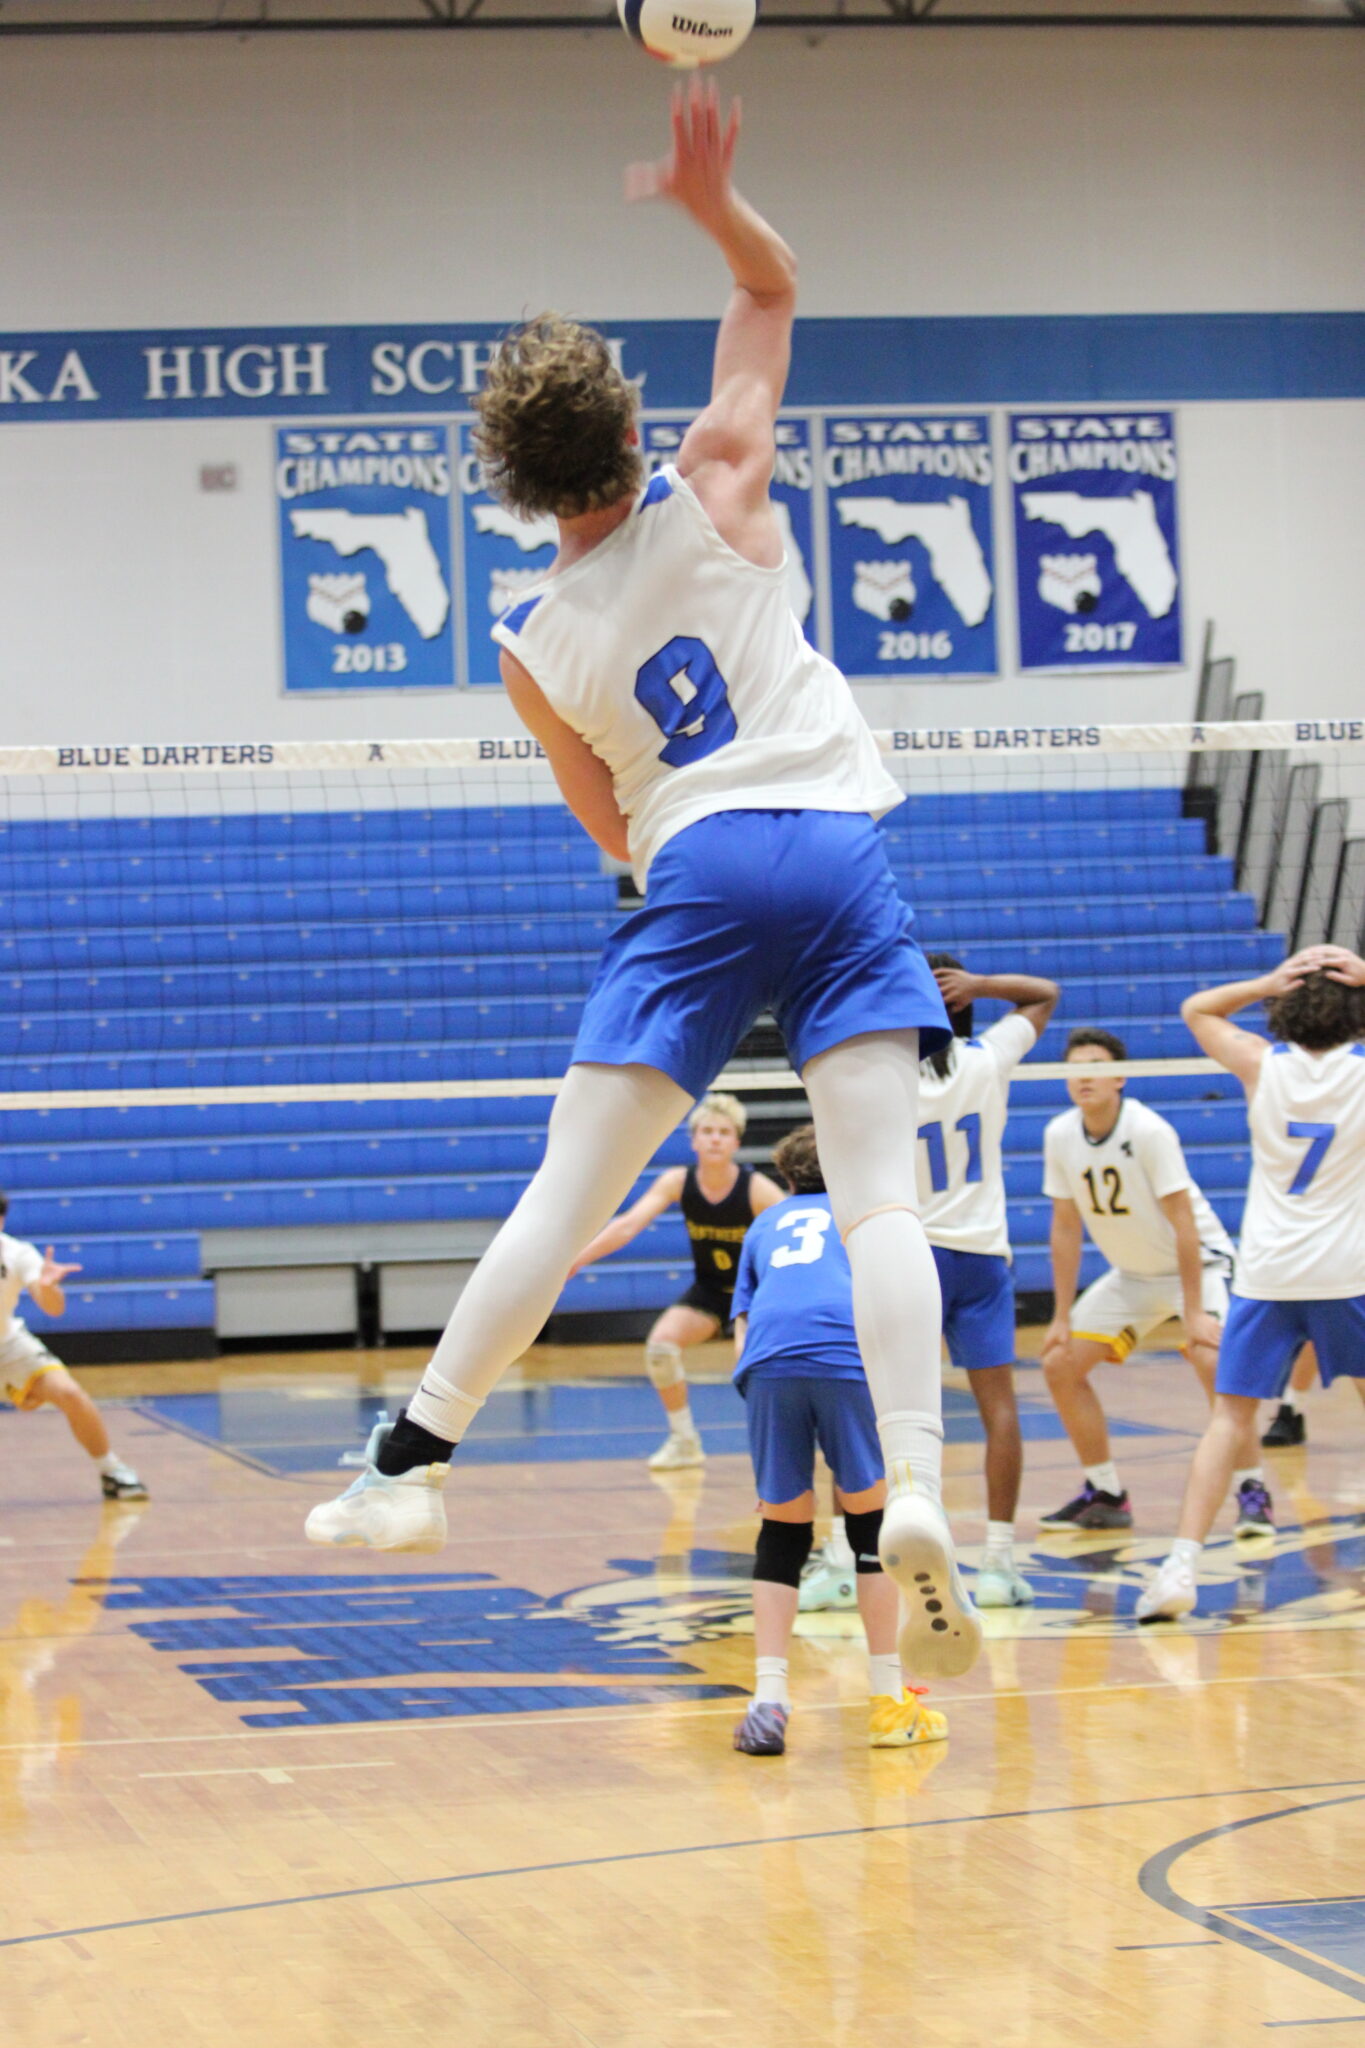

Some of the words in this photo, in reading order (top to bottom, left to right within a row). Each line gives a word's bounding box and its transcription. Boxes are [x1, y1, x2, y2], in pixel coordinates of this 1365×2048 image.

[671, 15, 733, 38] Wilson
[144, 343, 329, 399] HIGH
[371, 340, 648, 394] SCHL
[286, 432, 438, 454] STATE
[833, 421, 981, 443] STATE
[1016, 418, 1167, 440] STATE
[277, 453, 450, 499] CHAMPIONS
[824, 444, 993, 488] CHAMPIONS
[1010, 439, 1177, 483] CHAMPIONS
[877, 629, 953, 660] 2016
[1063, 621, 1137, 653] 2017
[332, 642, 408, 674] 2013
[634, 635, 739, 768] 9
[893, 730, 963, 750] BLUE
[974, 727, 1101, 749] DARTERS
[1295, 721, 1364, 741] BLUE
[58, 747, 131, 767] BLUE
[142, 744, 275, 766] DARTERS
[916, 1112, 984, 1194] 11
[1286, 1121, 1337, 1195] 7
[1082, 1165, 1130, 1215] 12
[769, 1207, 832, 1269] 3
